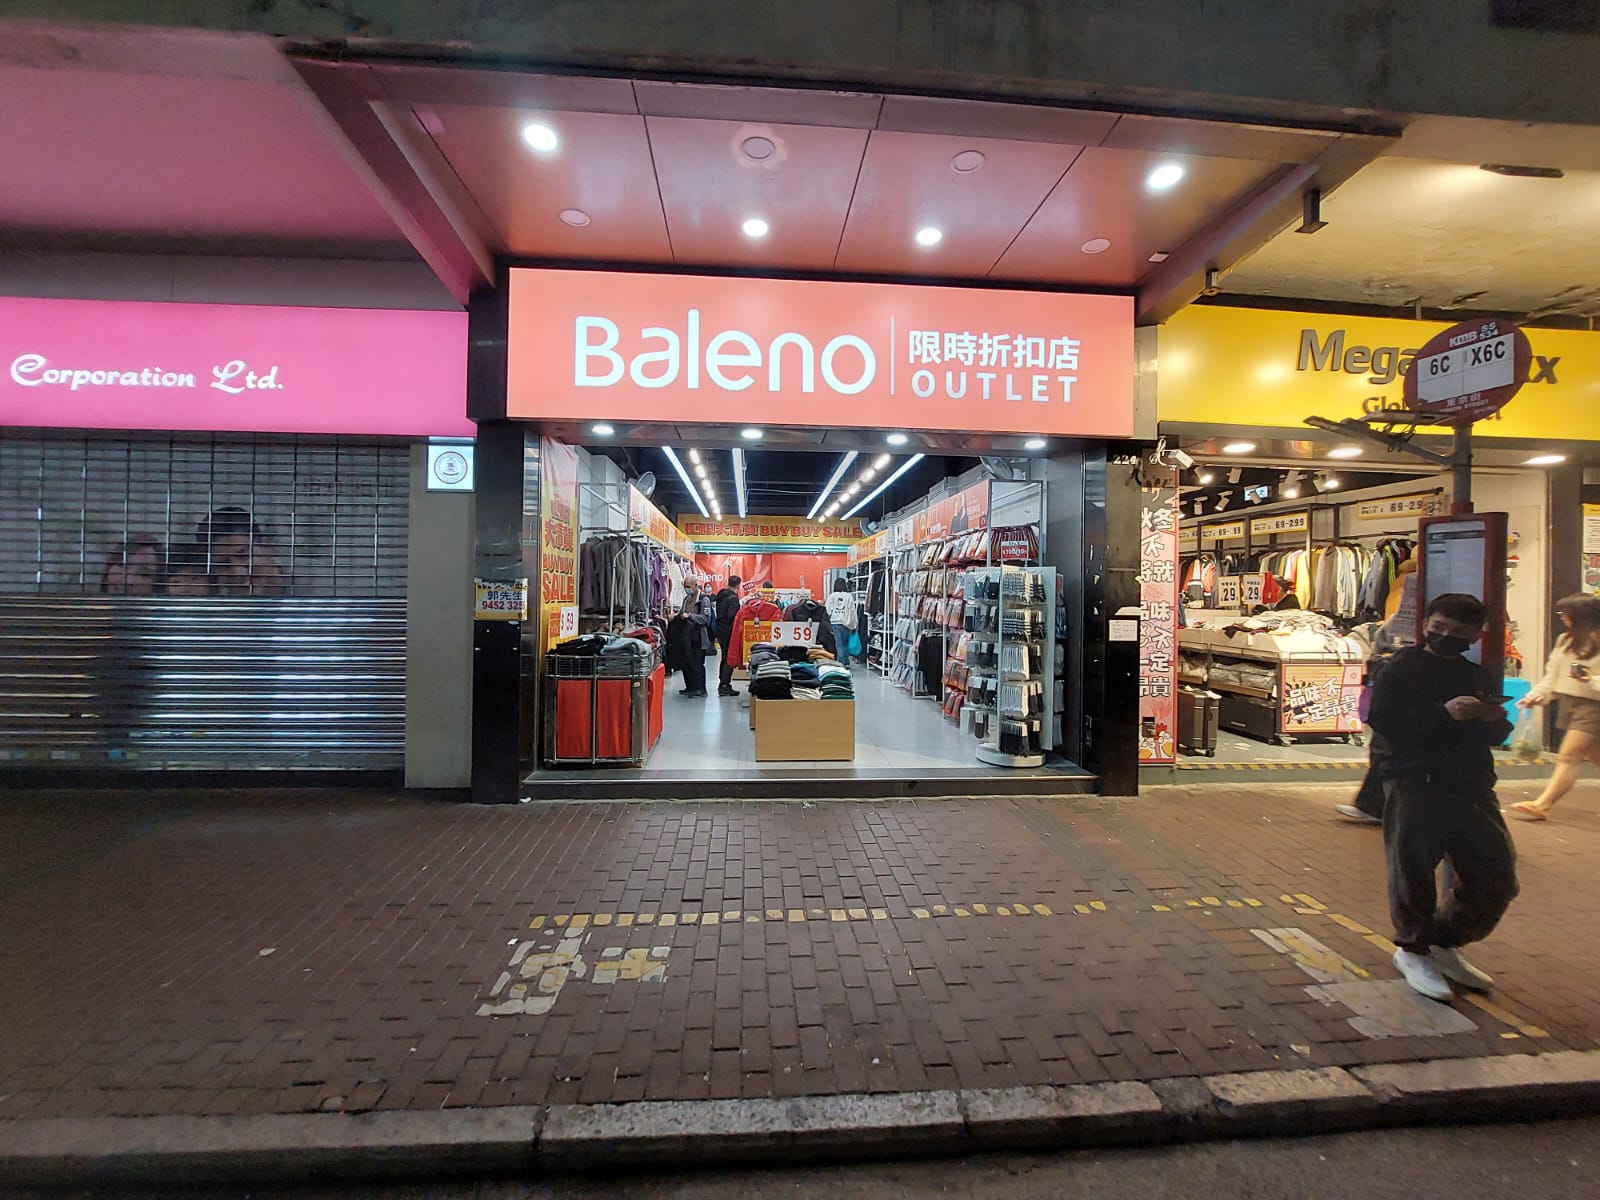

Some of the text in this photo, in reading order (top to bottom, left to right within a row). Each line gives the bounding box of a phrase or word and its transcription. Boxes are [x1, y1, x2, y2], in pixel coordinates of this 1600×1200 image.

[574, 308, 877, 395] Baleno
[908, 330, 1081, 370] 限時折扣店
[1471, 340, 1505, 366] X6C
[10, 353, 284, 394] Corporation Ltd.
[1430, 355, 1450, 375] 6C
[911, 369, 1078, 403] OUTLET
[822, 526, 862, 538] SALE
[1275, 518, 1305, 529] 69-299
[543, 573, 574, 604] SALE
[1223, 587, 1236, 601] 29
[1247, 586, 1259, 600] 29
[482, 601, 505, 610] 9452
[773, 626, 782, 640] $
[793, 627, 812, 641] 59
